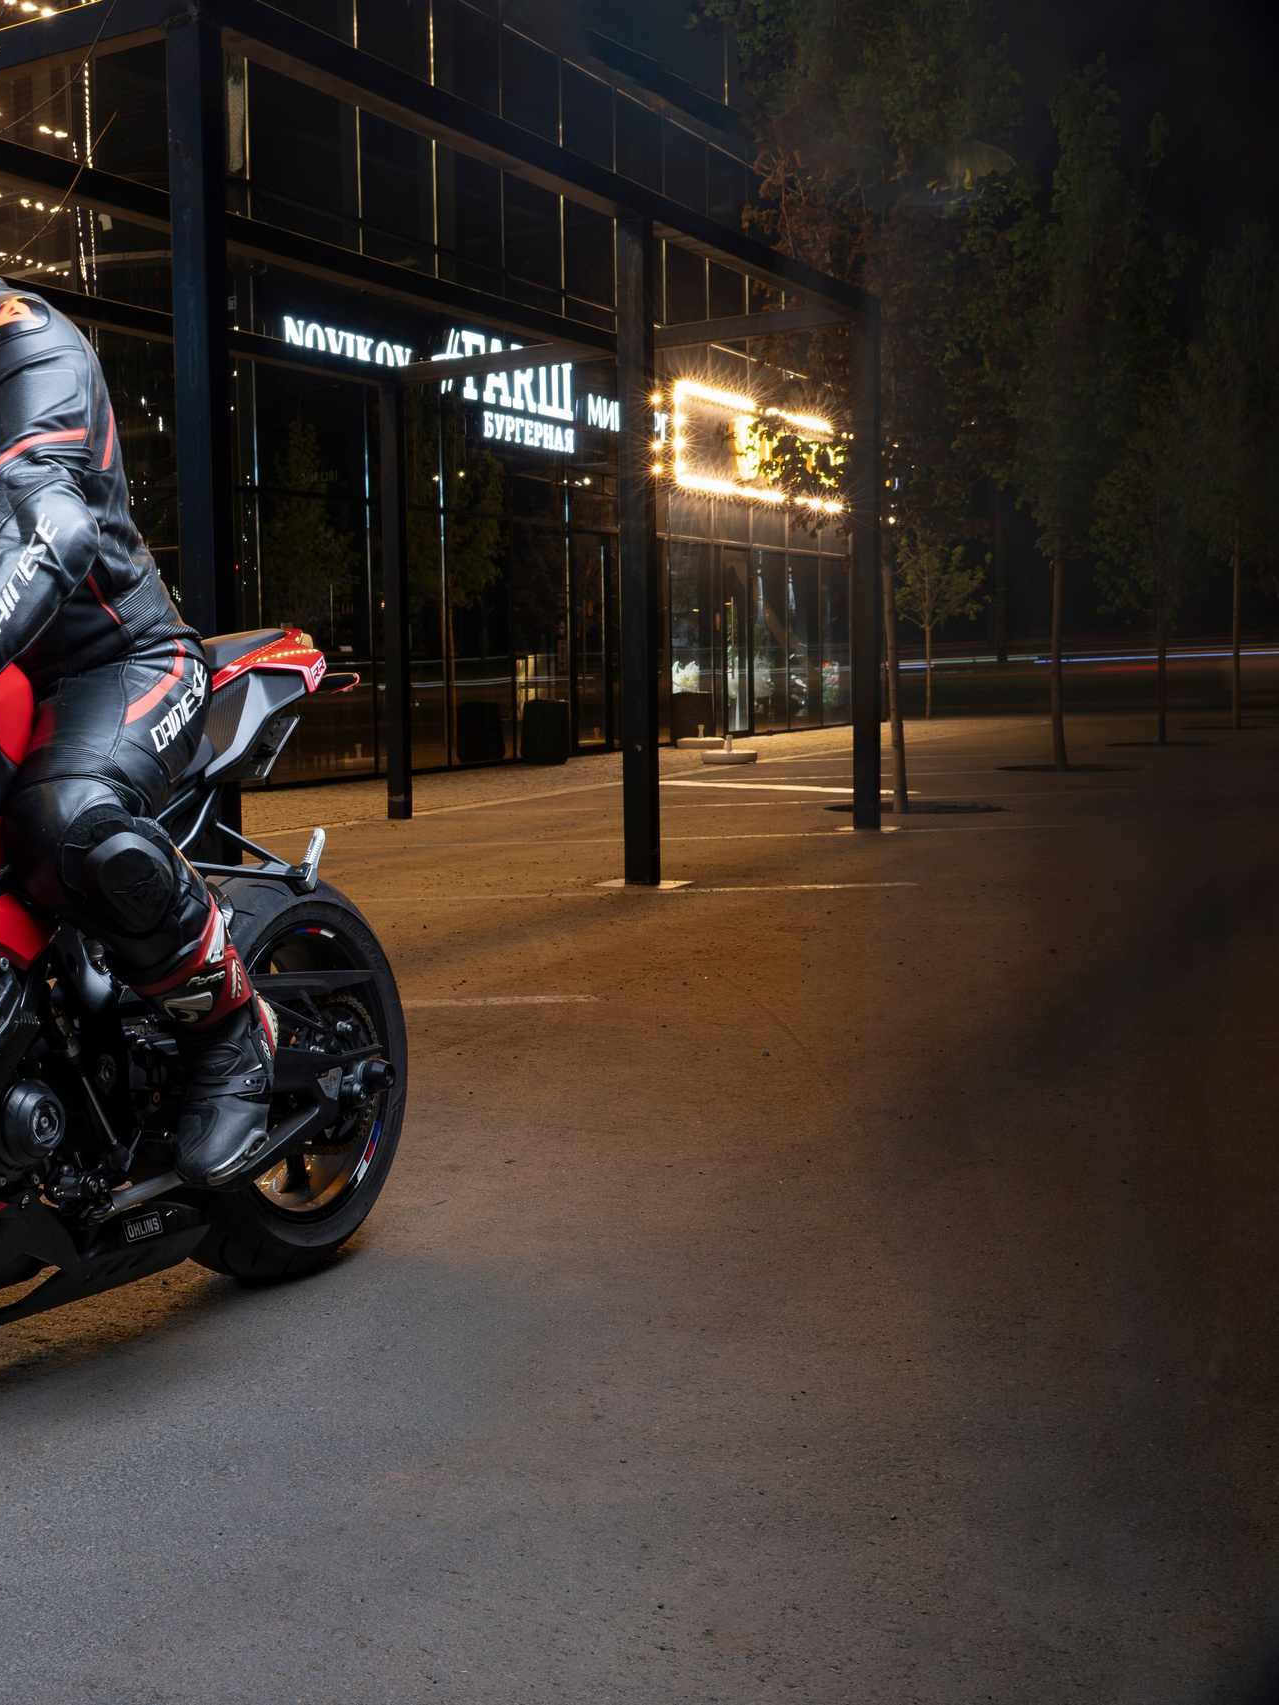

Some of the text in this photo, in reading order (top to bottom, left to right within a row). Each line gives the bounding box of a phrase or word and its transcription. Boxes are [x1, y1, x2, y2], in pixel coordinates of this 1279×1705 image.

[284, 315, 412, 367] NOVIKOV
[483, 410, 575, 454] БУРГЕРНАЯ
[125, 1216, 160, 1239] ÖHLINS
